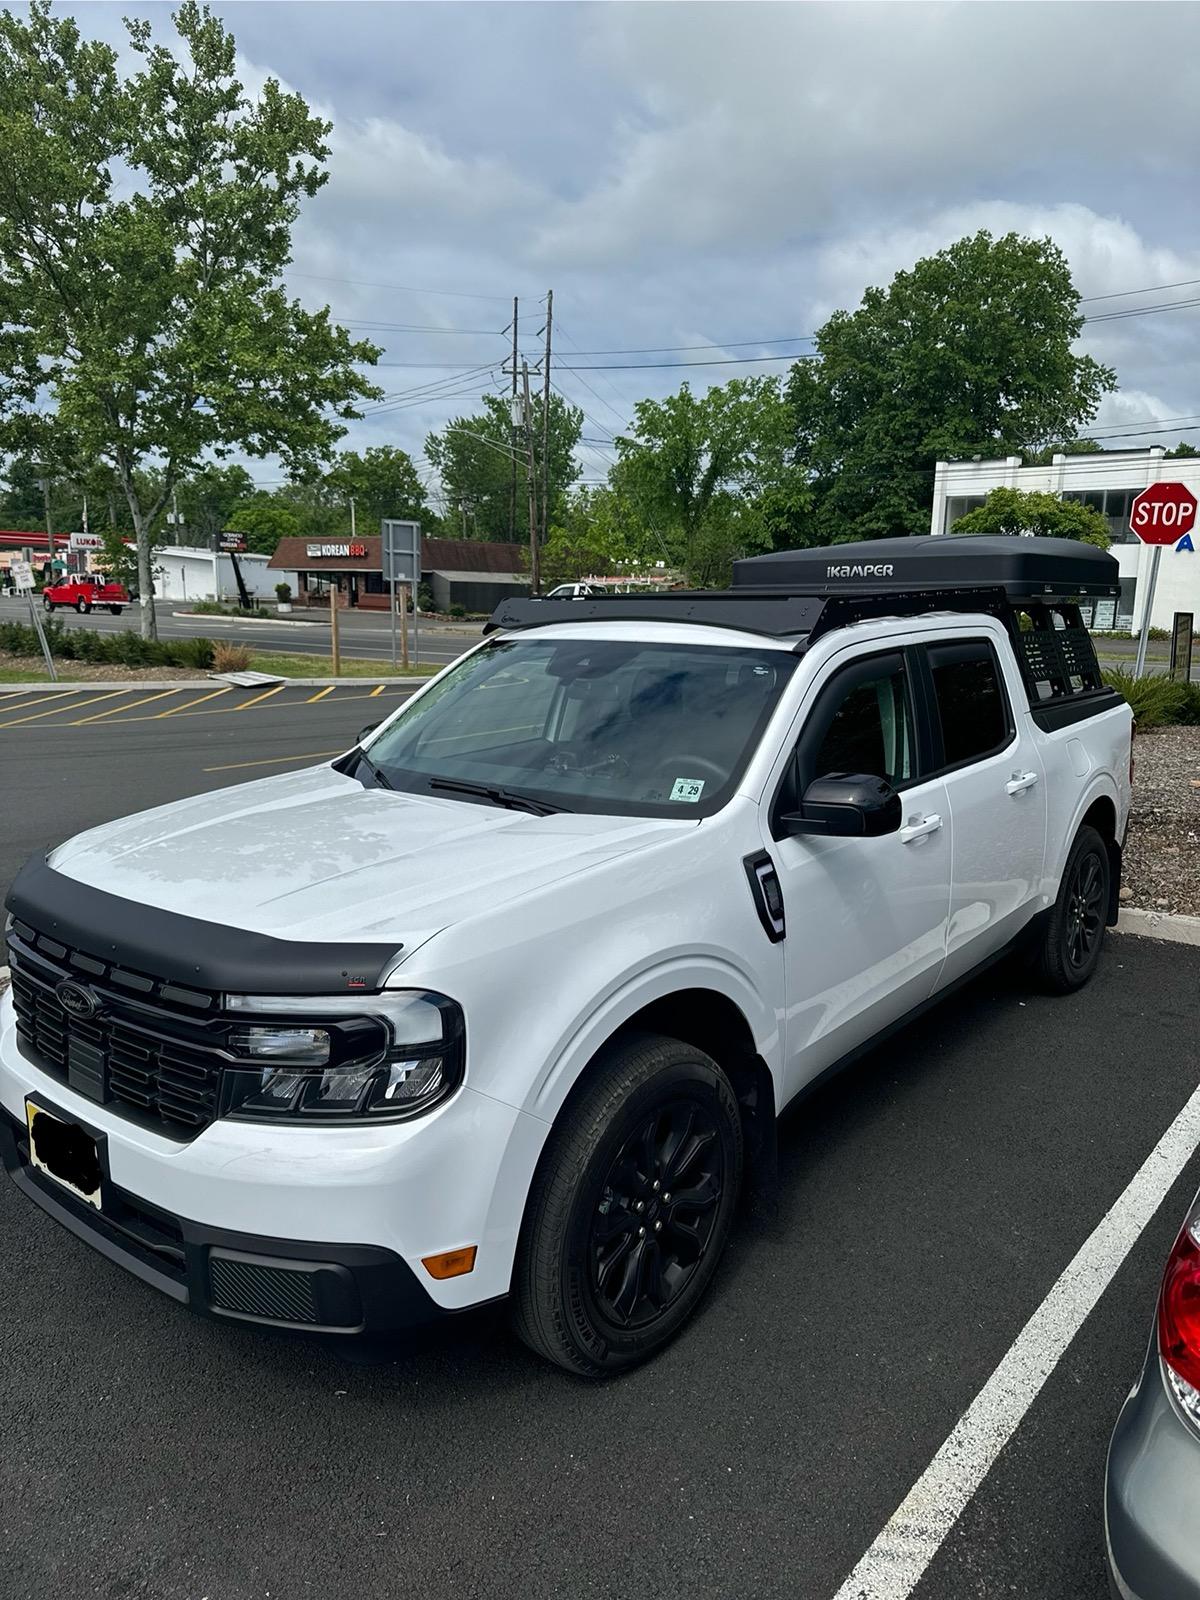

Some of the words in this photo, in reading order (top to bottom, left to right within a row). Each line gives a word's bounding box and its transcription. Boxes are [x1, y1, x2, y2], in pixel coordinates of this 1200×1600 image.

[1135, 502, 1193, 526] STOP
[321, 544, 350, 556] KOREAN
[350, 544, 365, 556] BBQ
[1175, 533, 1195, 552] A
[677, 785, 684, 794] 4
[688, 785, 699, 795] 29
